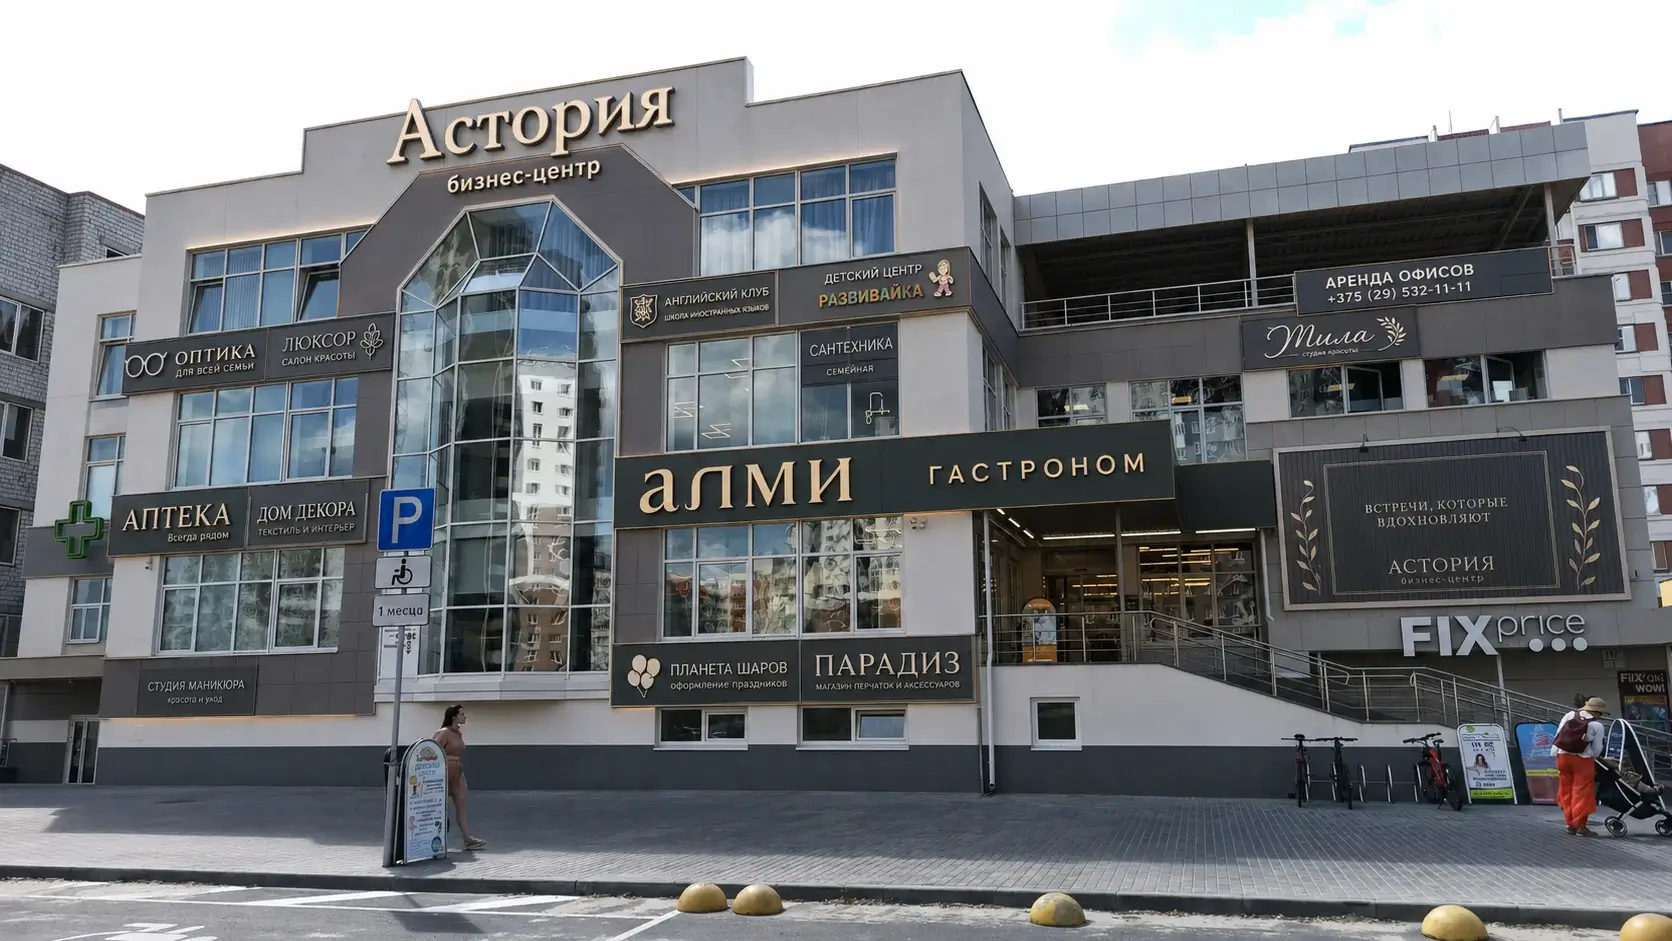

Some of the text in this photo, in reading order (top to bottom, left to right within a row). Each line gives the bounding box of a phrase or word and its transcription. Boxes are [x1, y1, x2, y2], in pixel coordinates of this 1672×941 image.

[386, 86, 675, 165] Астория
[447, 159, 601, 194] бизнес-центр
[825, 264, 922, 285] ДЕТСКИЙ ЦЕНТР
[1325, 263, 1474, 289] АРЕНДА ОФИСОВ
[664, 286, 770, 307] АНГЛИЙСКИЙ КЛУБ
[819, 283, 923, 308] РАЗВИВАЙКА
[1328, 281, 1471, 304] +375 (29) 532-11-11
[282, 330, 356, 353] ЛЮКСОР
[809, 337, 893, 357] САНТЕХНИКА
[175, 343, 256, 366] ОПТИКА
[282, 351, 356, 366] САЛОН КРАСОТЫ
[175, 362, 254, 378] ДЛЯ ВСЕЙ СЕМЬИ
[826, 364, 874, 376] СЕМЕЙНАЯ
[928, 452, 1146, 485] ГАСТРОНОМ
[257, 501, 356, 524] ДОМ ДЕКОРА
[1365, 497, 1508, 514] ВСТРЕЧИ, КОТОРЫЕ
[122, 503, 231, 532] АПТЕКА
[391, 496, 423, 544] P
[1377, 512, 1491, 528] ВДОХНОВЛЯЮТ
[167, 531, 229, 543] Всегда рядом
[258, 522, 356, 537] ТЕКСТИЛЬ И ИНТЕРЬЕР
[1388, 556, 1495, 575] АСТОРИЯ
[1401, 574, 1484, 585] бизнес-центр
[378, 605, 423, 617] 1 месца
[1400, 614, 1586, 657] FIX price
[670, 661, 788, 676] ПЛАНЕТА ШАРОВ
[815, 651, 960, 679] ПАРАДИЗ
[148, 679, 245, 692] СТУДИЯ МАНИКЮРА
[670, 679, 788, 691] оформление праздников
[815, 683, 852, 691] МАГАЗИН
[854, 682, 894, 690] ПЕРЧАТОК
[904, 680, 960, 689] АКСЕССУАРОВ
